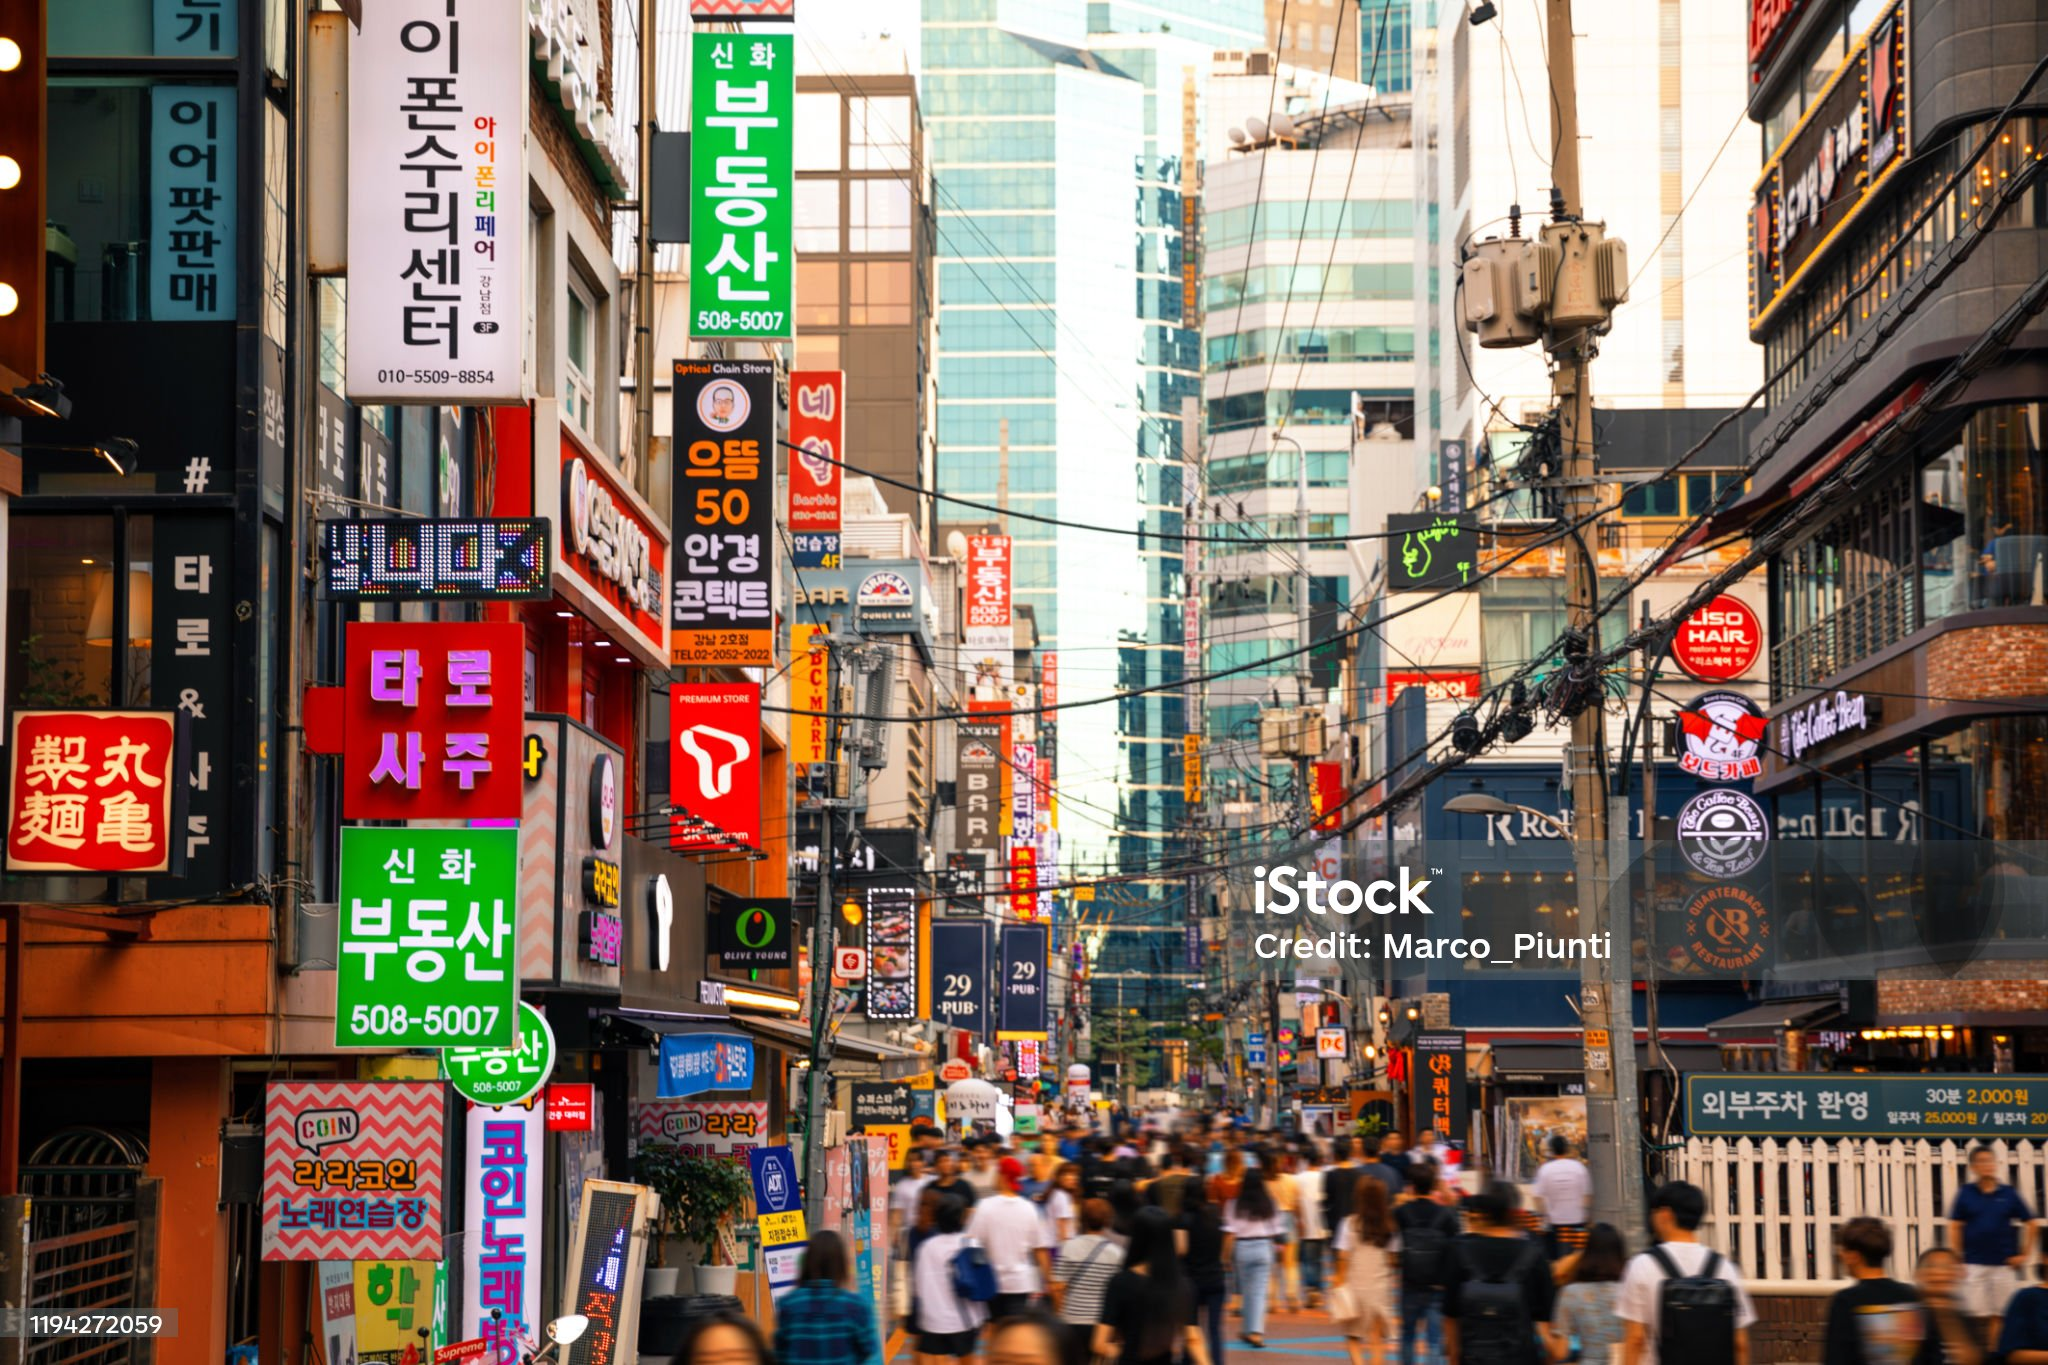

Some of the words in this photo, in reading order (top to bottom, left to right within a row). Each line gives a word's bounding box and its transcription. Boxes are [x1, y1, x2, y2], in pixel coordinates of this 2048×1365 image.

[711, 41, 776, 69] 신화
[400, 0, 463, 359] 이폰수리센터
[474, 116, 496, 261] 아이폰리페어
[705, 79, 778, 301] 부동산
[168, 101, 221, 312] 이어팟판매
[479, 275, 492, 315] 강남점
[480, 322, 493, 333] 3F
[698, 311, 783, 330] 508-5007
[377, 369, 495, 384] 010-5509-8854
[675, 364, 711, 374] Optical
[713, 364, 740, 373] Chain
[743, 364, 772, 374] Store
[686, 440, 760, 480] 으뜸
[695, 489, 750, 525] 50
[684, 533, 759, 574] 안경
[794, 536, 839, 551] 연습장
[821, 554, 840, 568] 4F
[973, 549, 1007, 605] 부동산
[673, 580, 770, 621] 콘택트
[694, 633, 716, 645] 강남
[720, 633, 749, 645] 2호점
[370, 650, 493, 707] 타로
[680, 695, 721, 703] PREMIUM
[723, 695, 750, 703] STORE
[1808, 699, 1836, 745] Coffee
[1836, 691, 1866, 731] Bean
[369, 732, 493, 790] 사주
[1680, 752, 1761, 780] 보드카페
[967, 774, 989, 836] BAR
[1696, 793, 1734, 810] Coffee
[383, 848, 475, 884] 신화
[1689, 886, 1767, 917] QUARTERBACK
[343, 898, 511, 982] 부동산
[724, 952, 751, 960] OLIVE
[755, 952, 787, 960] YOUNG
[1691, 942, 1765, 970] RESTAURANT
[1012, 961, 1036, 980] 29
[943, 975, 971, 997] 29
[1011, 984, 1034, 995] PUB
[350, 1004, 500, 1036] 508-5007
[942, 1001, 974, 1015] PUB
[1319, 1035, 1344, 1051] PC
[473, 1081, 521, 1093] 508-5007
[1926, 1089, 1962, 1104] 30분
[1967, 1089, 2028, 1106] 2,000원
[1702, 1090, 1807, 1119] 외부주차
[1817, 1091, 1869, 1120] 환영
[1924, 1111, 1978, 1126] 25,000원
[301, 1116, 352, 1139] COIN
[666, 1117, 698, 1130] COIN
[706, 1112, 757, 1138] 라라
[293, 1159, 417, 1191] 라라코인
[767, 1174, 783, 1193] ADT
[279, 1198, 430, 1230] 노래연습장
[437, 1340, 485, 1362] Supreme
